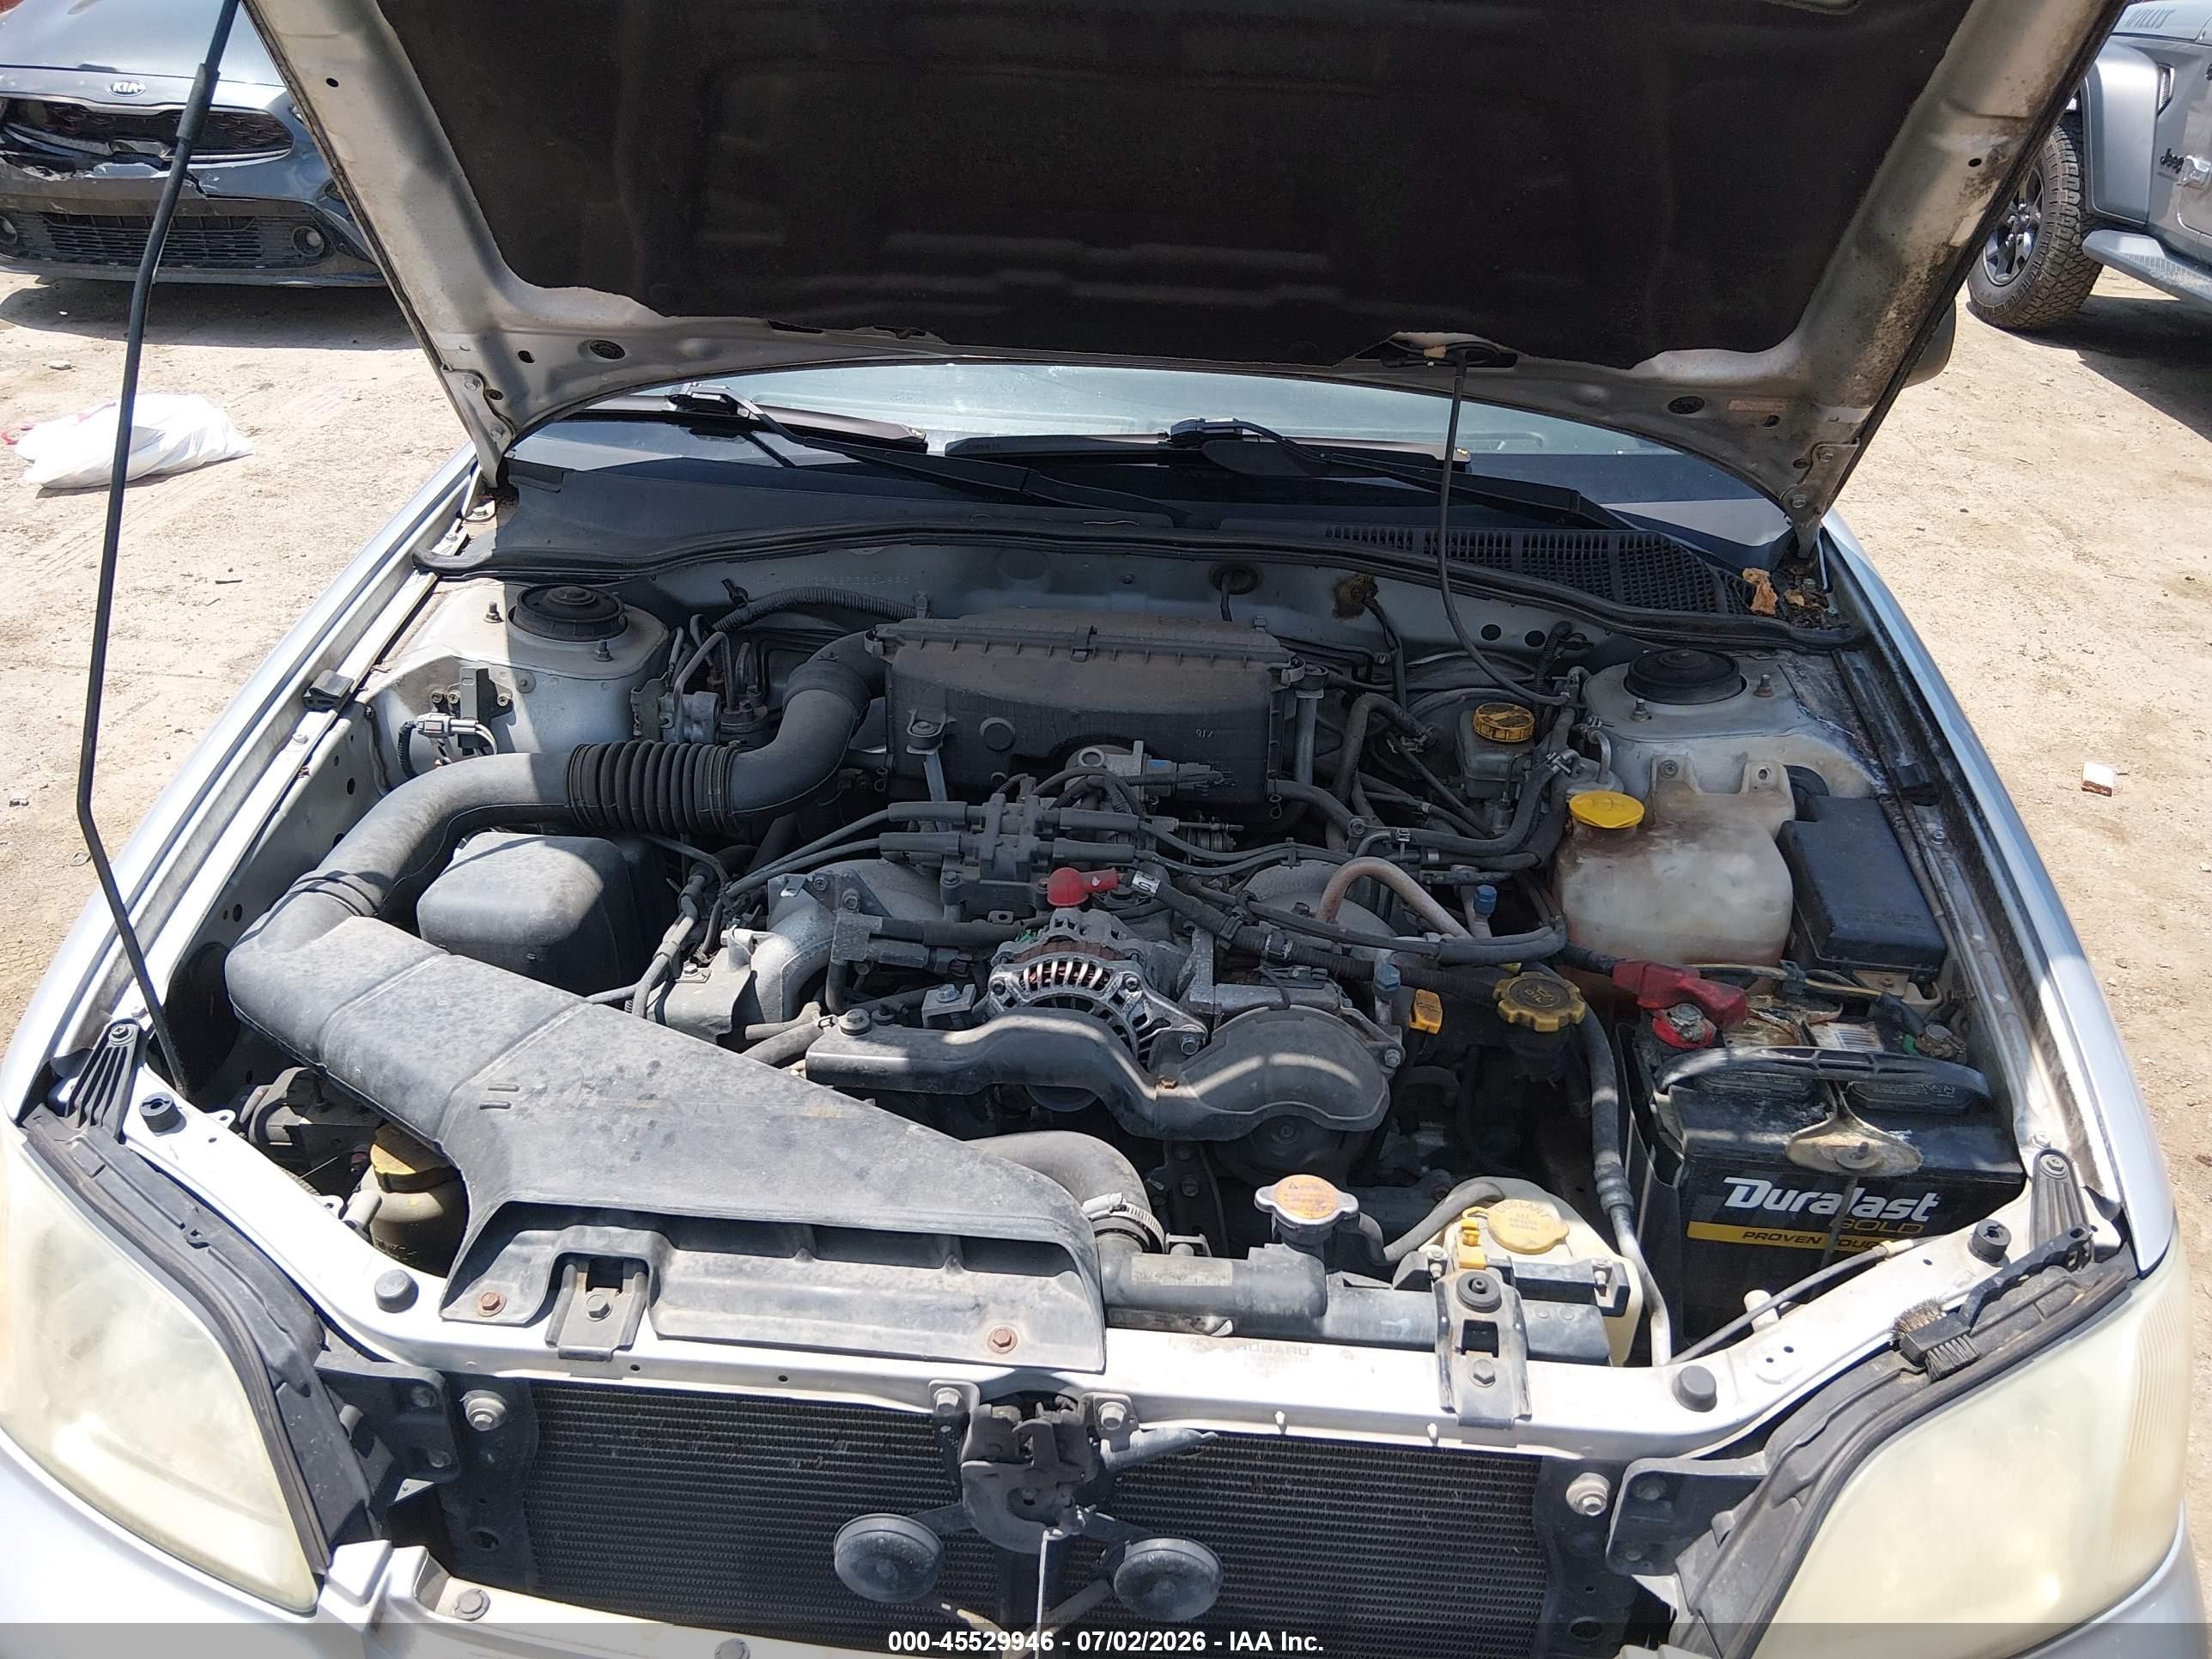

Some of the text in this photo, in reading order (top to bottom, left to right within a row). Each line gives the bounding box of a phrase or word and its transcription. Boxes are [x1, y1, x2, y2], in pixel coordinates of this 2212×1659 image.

[112, 82, 138, 93] KIA
[2160, 148, 2185, 174] Jeep
[1723, 1176, 1939, 1222] Duralast
[1495, 1200, 1553, 1219] COOLANT
[1829, 1218, 1923, 1234] GOLD
[1742, 1231, 1821, 1244] PROVEN
